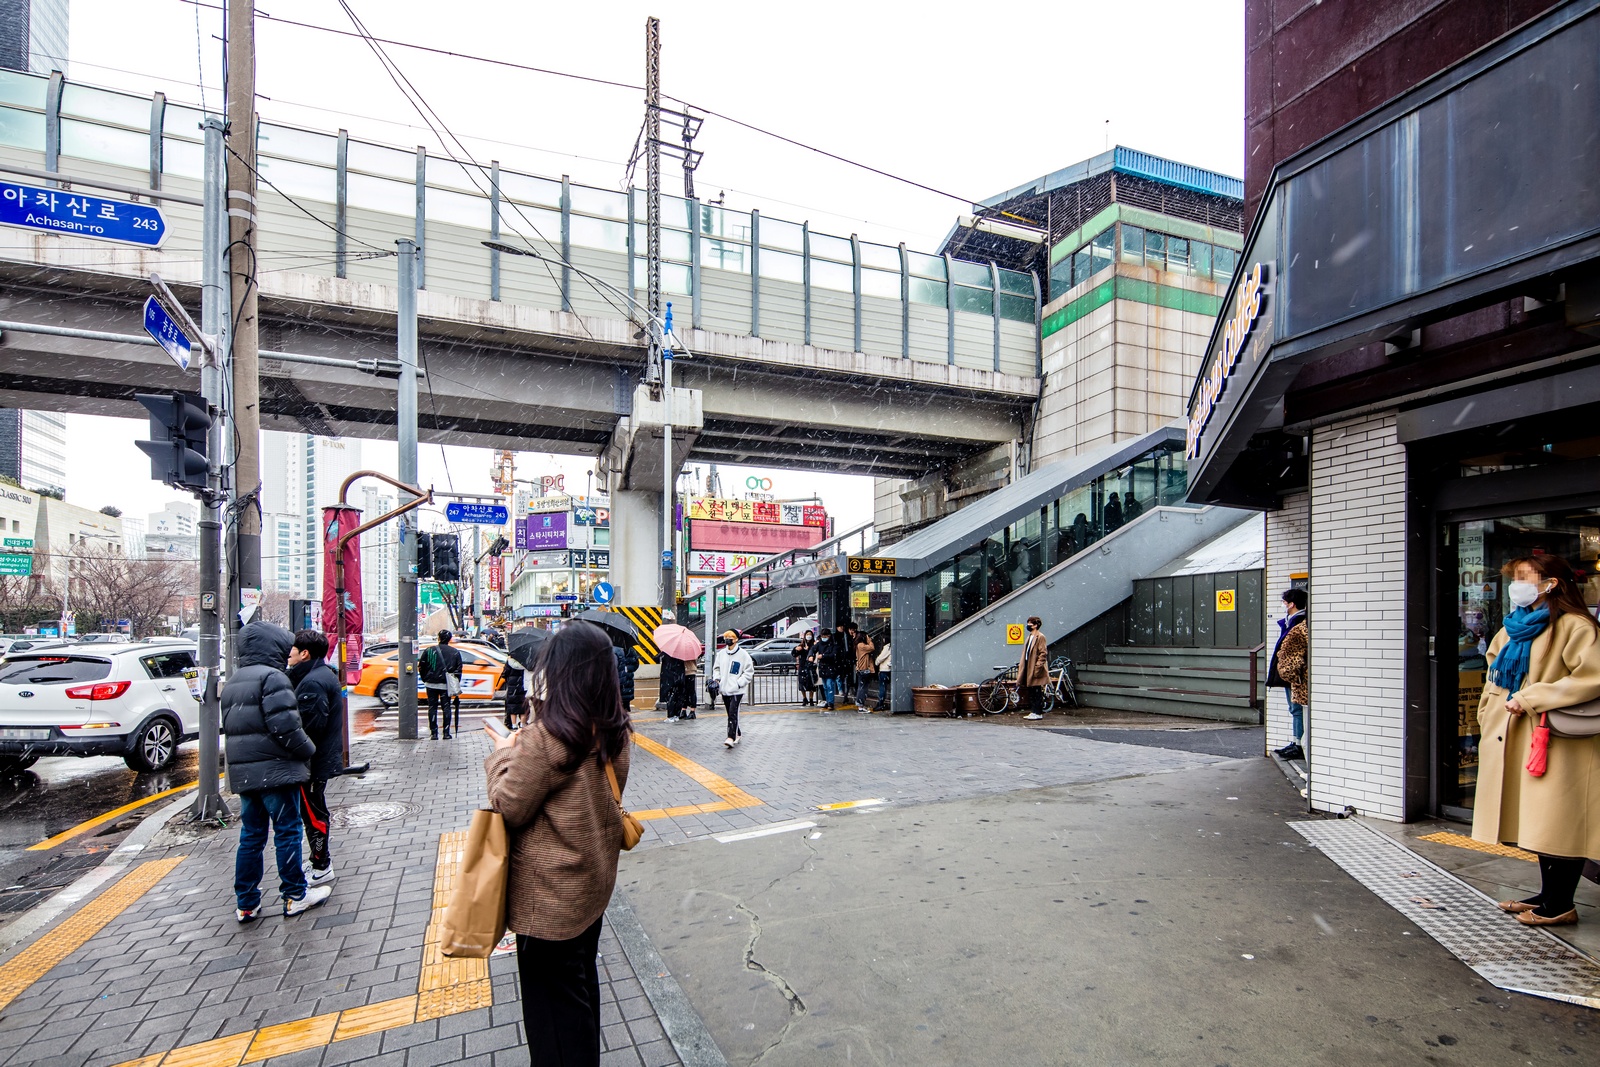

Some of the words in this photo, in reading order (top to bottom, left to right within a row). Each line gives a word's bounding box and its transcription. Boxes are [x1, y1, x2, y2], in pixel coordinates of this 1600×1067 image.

[3, 187, 120, 221] 아차산로
[25, 213, 104, 234] Achasan-ro
[132, 217, 158, 231] 243
[1222, 262, 1262, 379] Coffee
[163, 316, 179, 343] 능동로
[543, 474, 565, 493] PC
[22, 495, 32, 505] 500
[462, 504, 494, 514] 아차산로
[595, 508, 610, 525] P
[517, 528, 526, 546] 치과
[529, 530, 566, 540] 스타시티치과
[862, 559, 894, 570] 출입구
